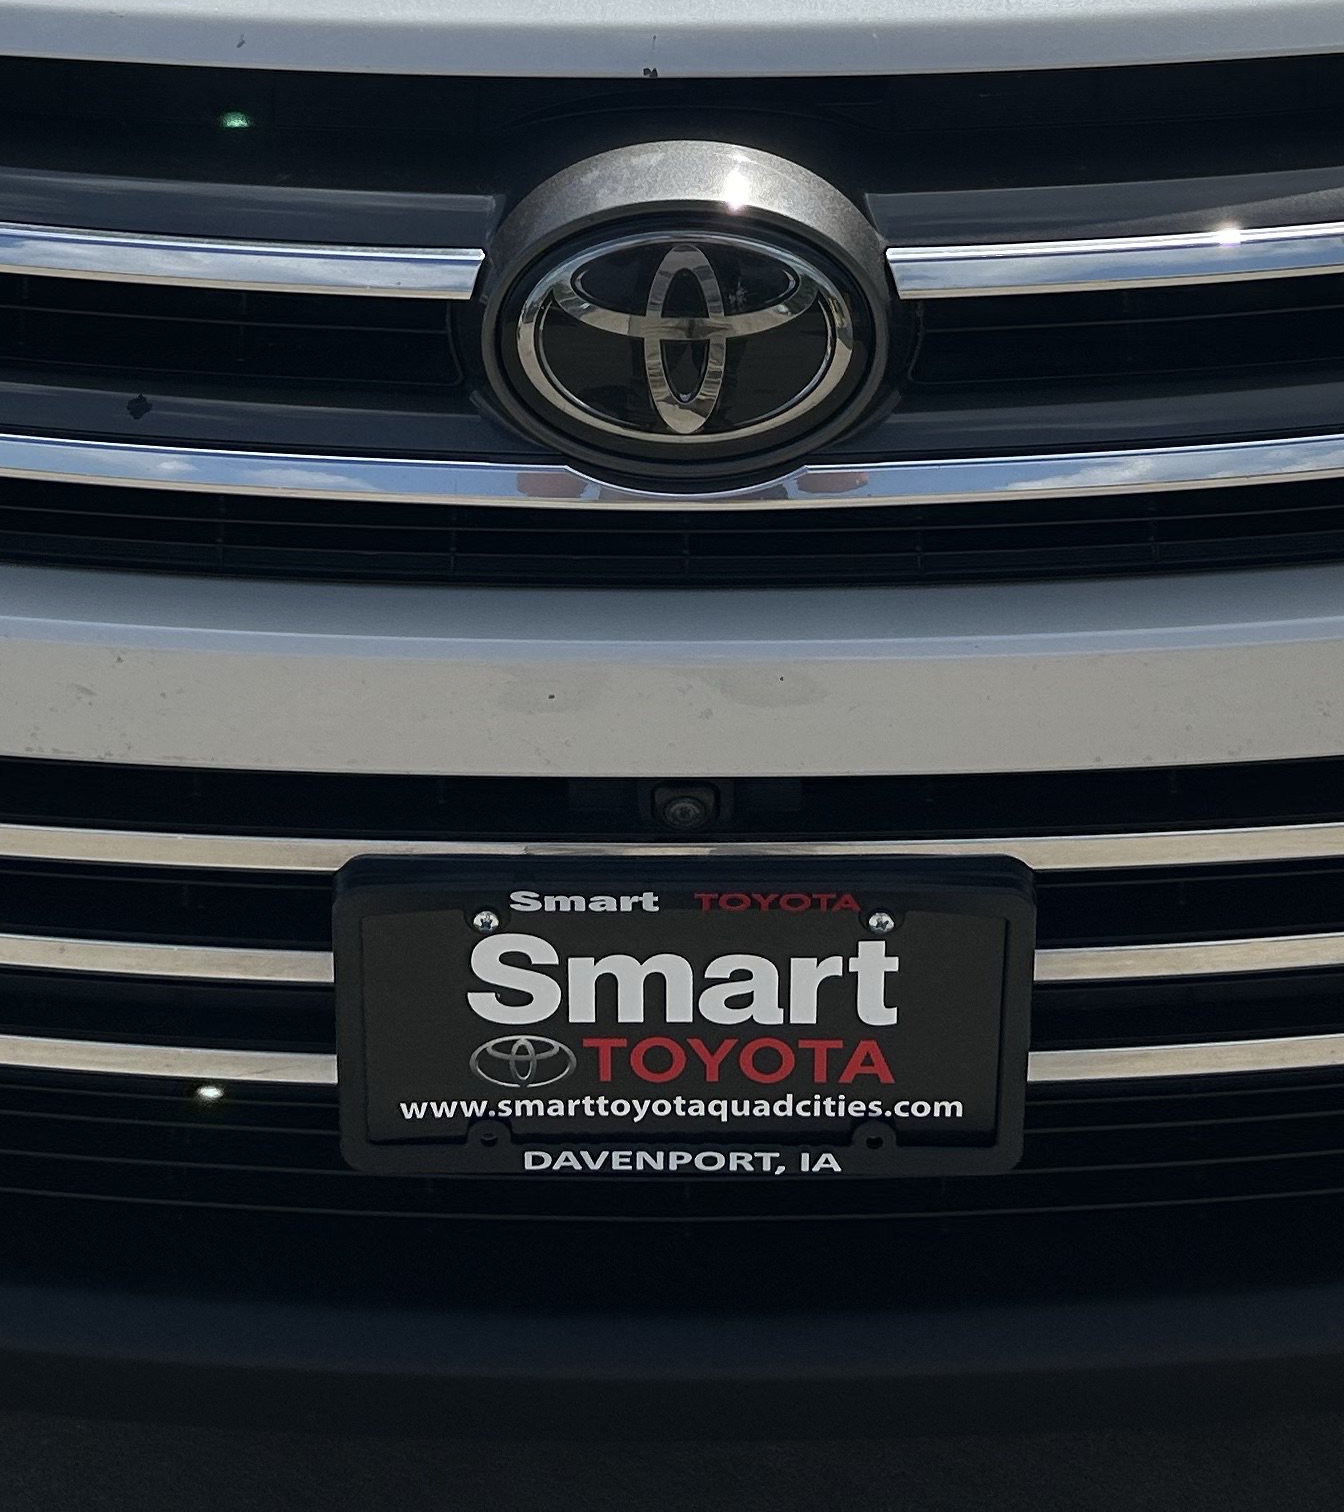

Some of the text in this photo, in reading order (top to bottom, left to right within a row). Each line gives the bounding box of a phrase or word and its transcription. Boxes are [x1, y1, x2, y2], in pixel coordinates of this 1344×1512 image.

[509, 890, 862, 913] Smart TOYOTA
[466, 933, 900, 1026] Smart
[581, 1036, 896, 1085] TOYOTA
[399, 1093, 964, 1123] www.smarttoyotaquadcities.com
[523, 1150, 843, 1176] DAVENPORT, IA
